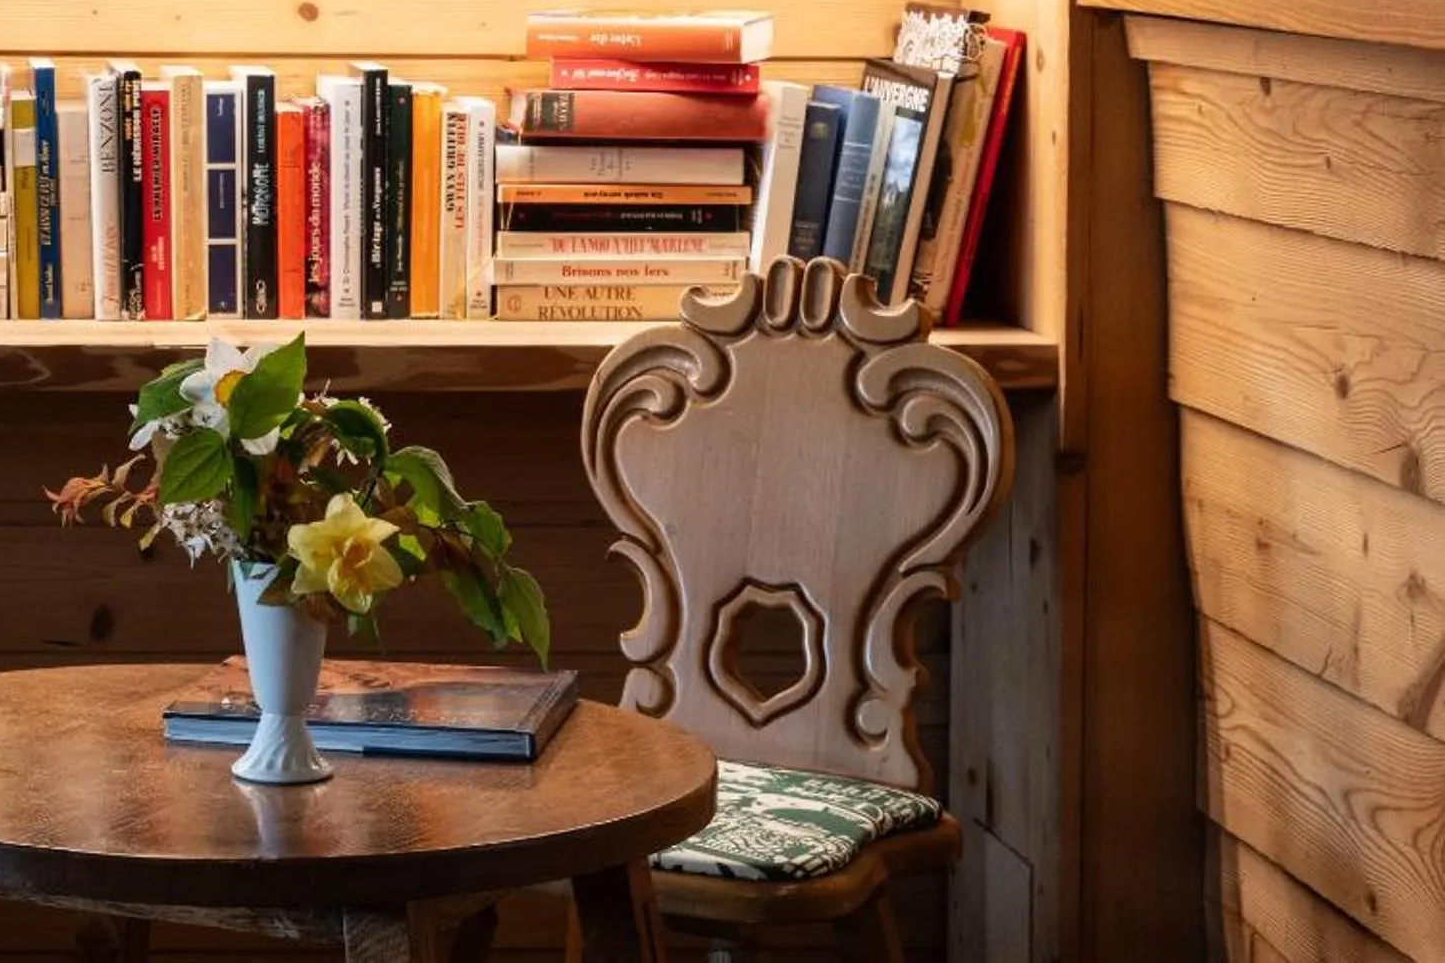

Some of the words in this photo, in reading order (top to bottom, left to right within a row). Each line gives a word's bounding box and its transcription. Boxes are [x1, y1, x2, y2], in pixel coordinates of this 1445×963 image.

[308, 161, 321, 208] monde
[616, 266, 640, 277] nos
[543, 285, 582, 300] UNE
[584, 285, 635, 300] AUTRE
[537, 302, 643, 320] RÉVOLUTION
